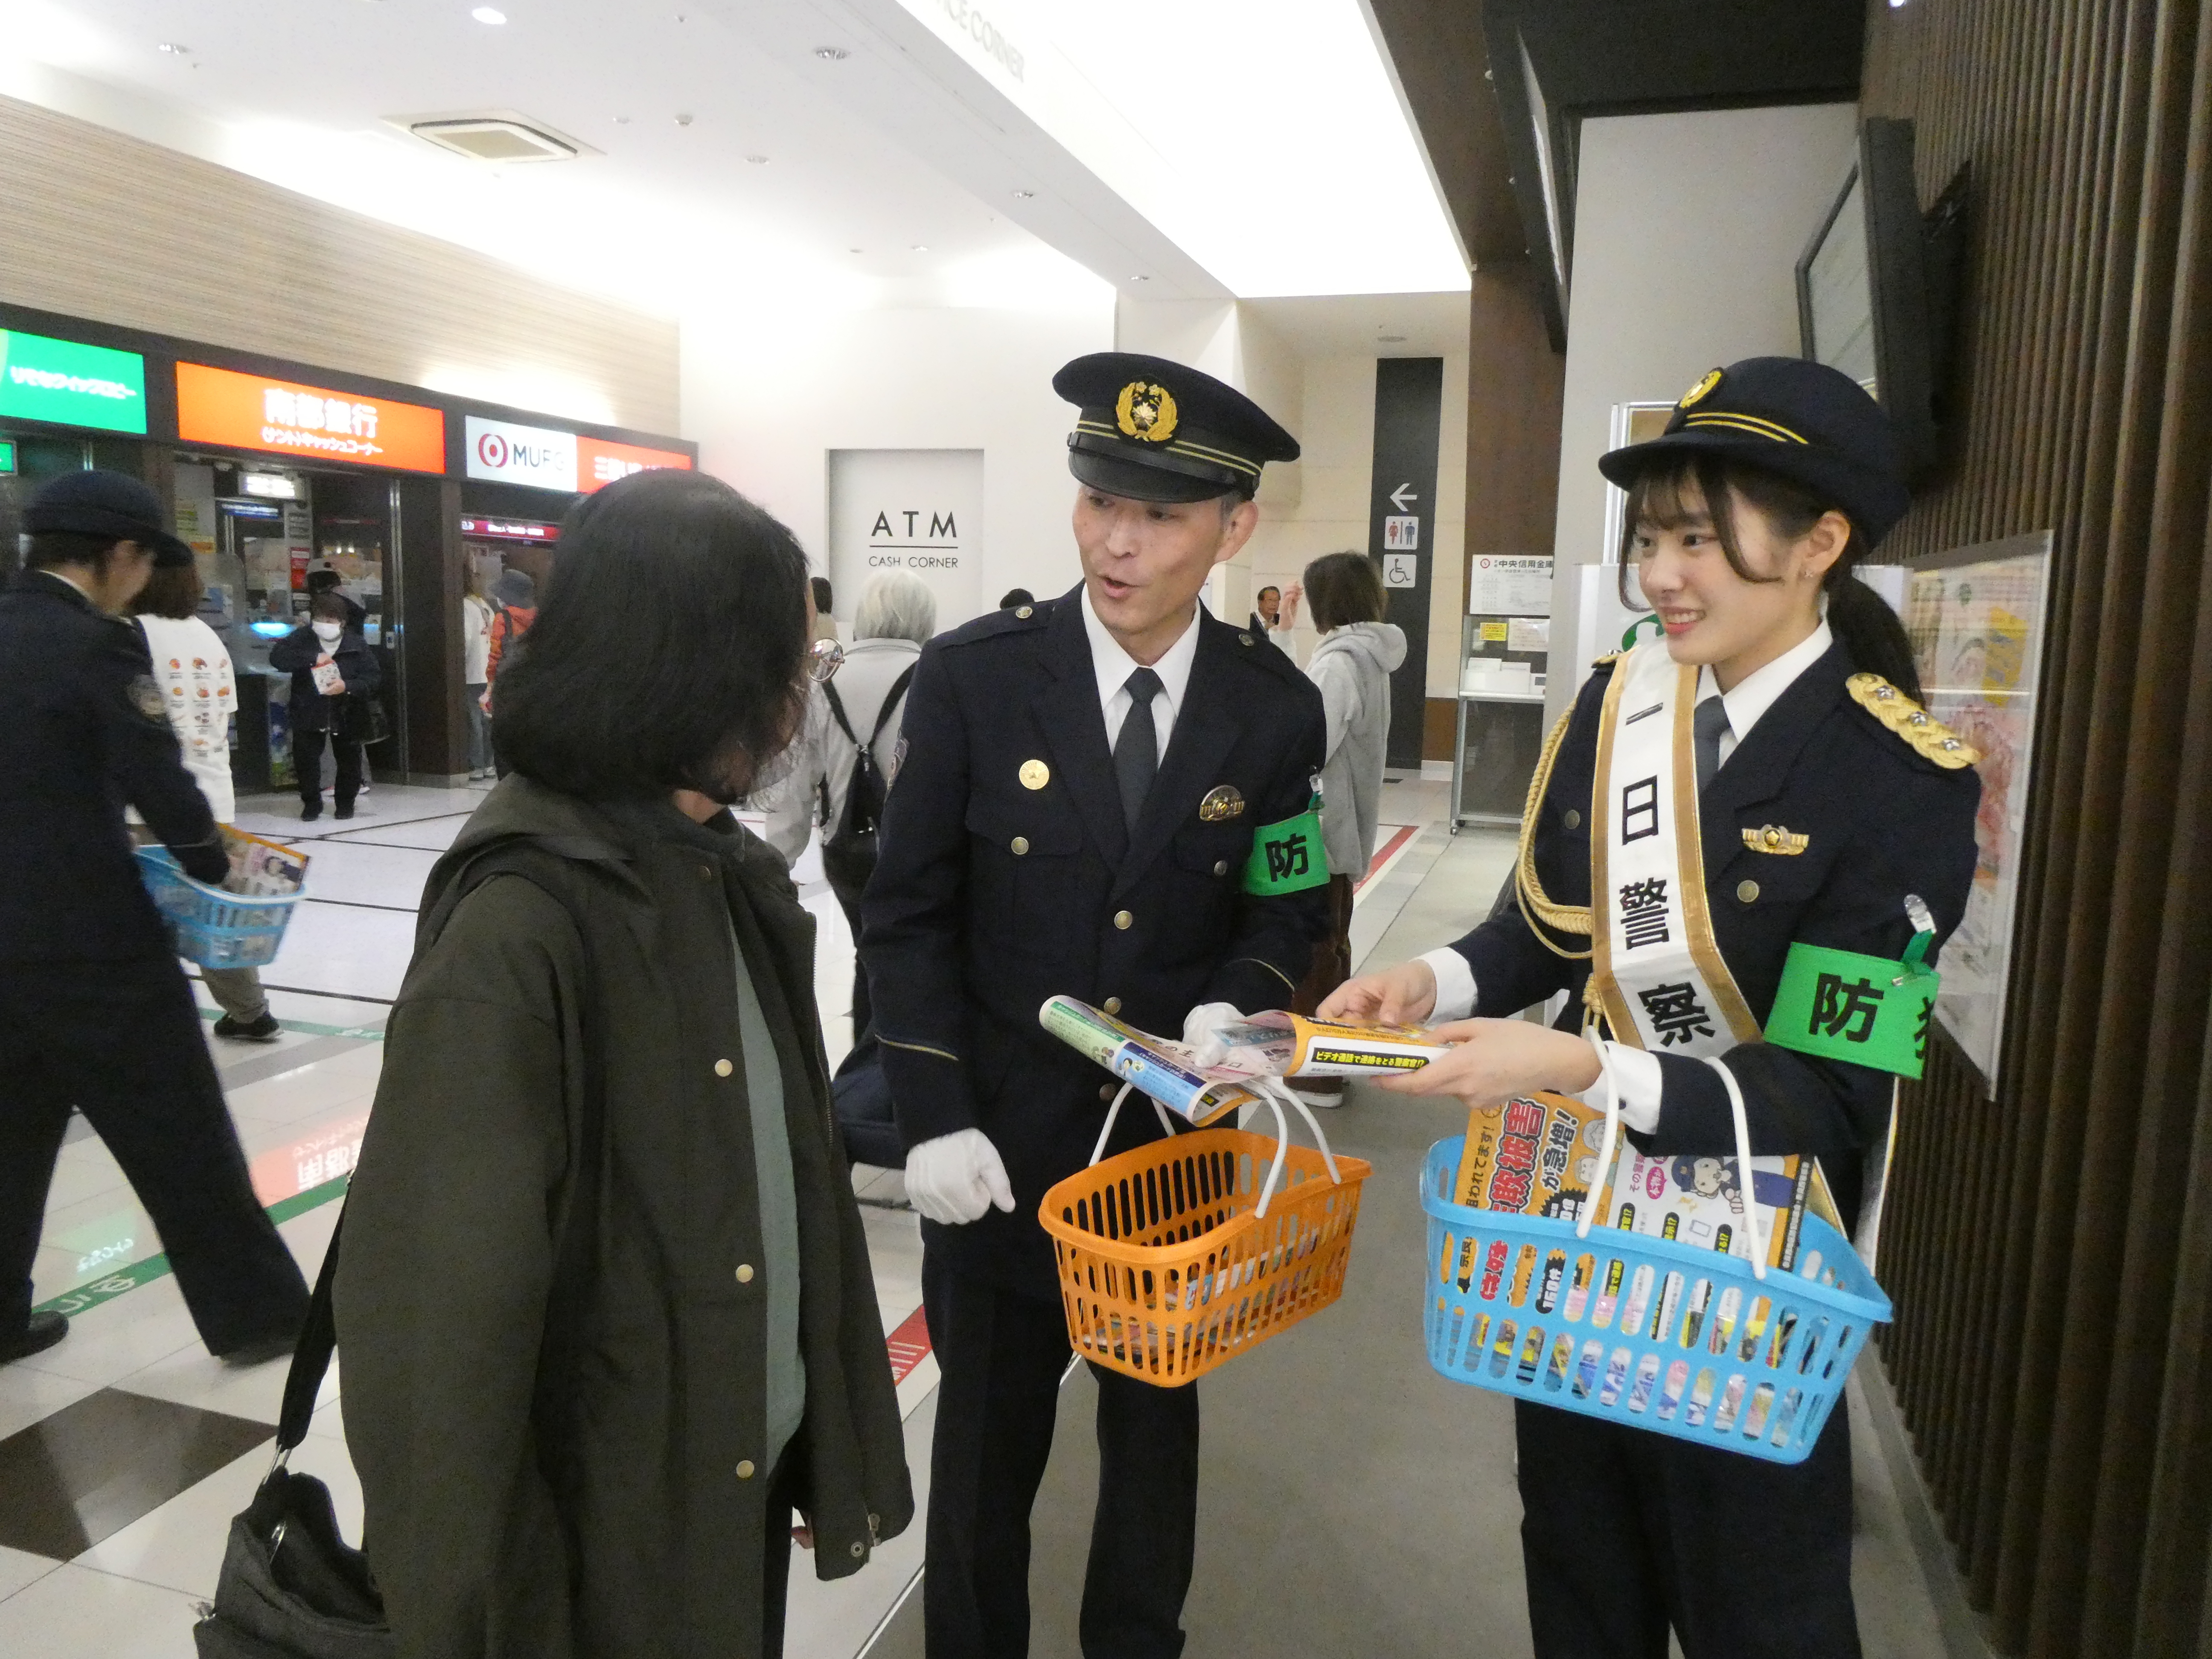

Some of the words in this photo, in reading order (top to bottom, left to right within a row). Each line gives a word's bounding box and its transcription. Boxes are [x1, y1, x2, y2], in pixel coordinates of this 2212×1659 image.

[265, 388, 378, 438] 南都銀行
[513, 443, 565, 471] MUFG
[871, 511, 957, 537] ATM
[869, 556, 900, 567] CASH
[908, 557, 958, 568] CORNER
[1265, 833, 1309, 882] 防
[1620, 702, 1715, 1047] 一日警察
[1541, 1109, 1577, 1191] が急増!
